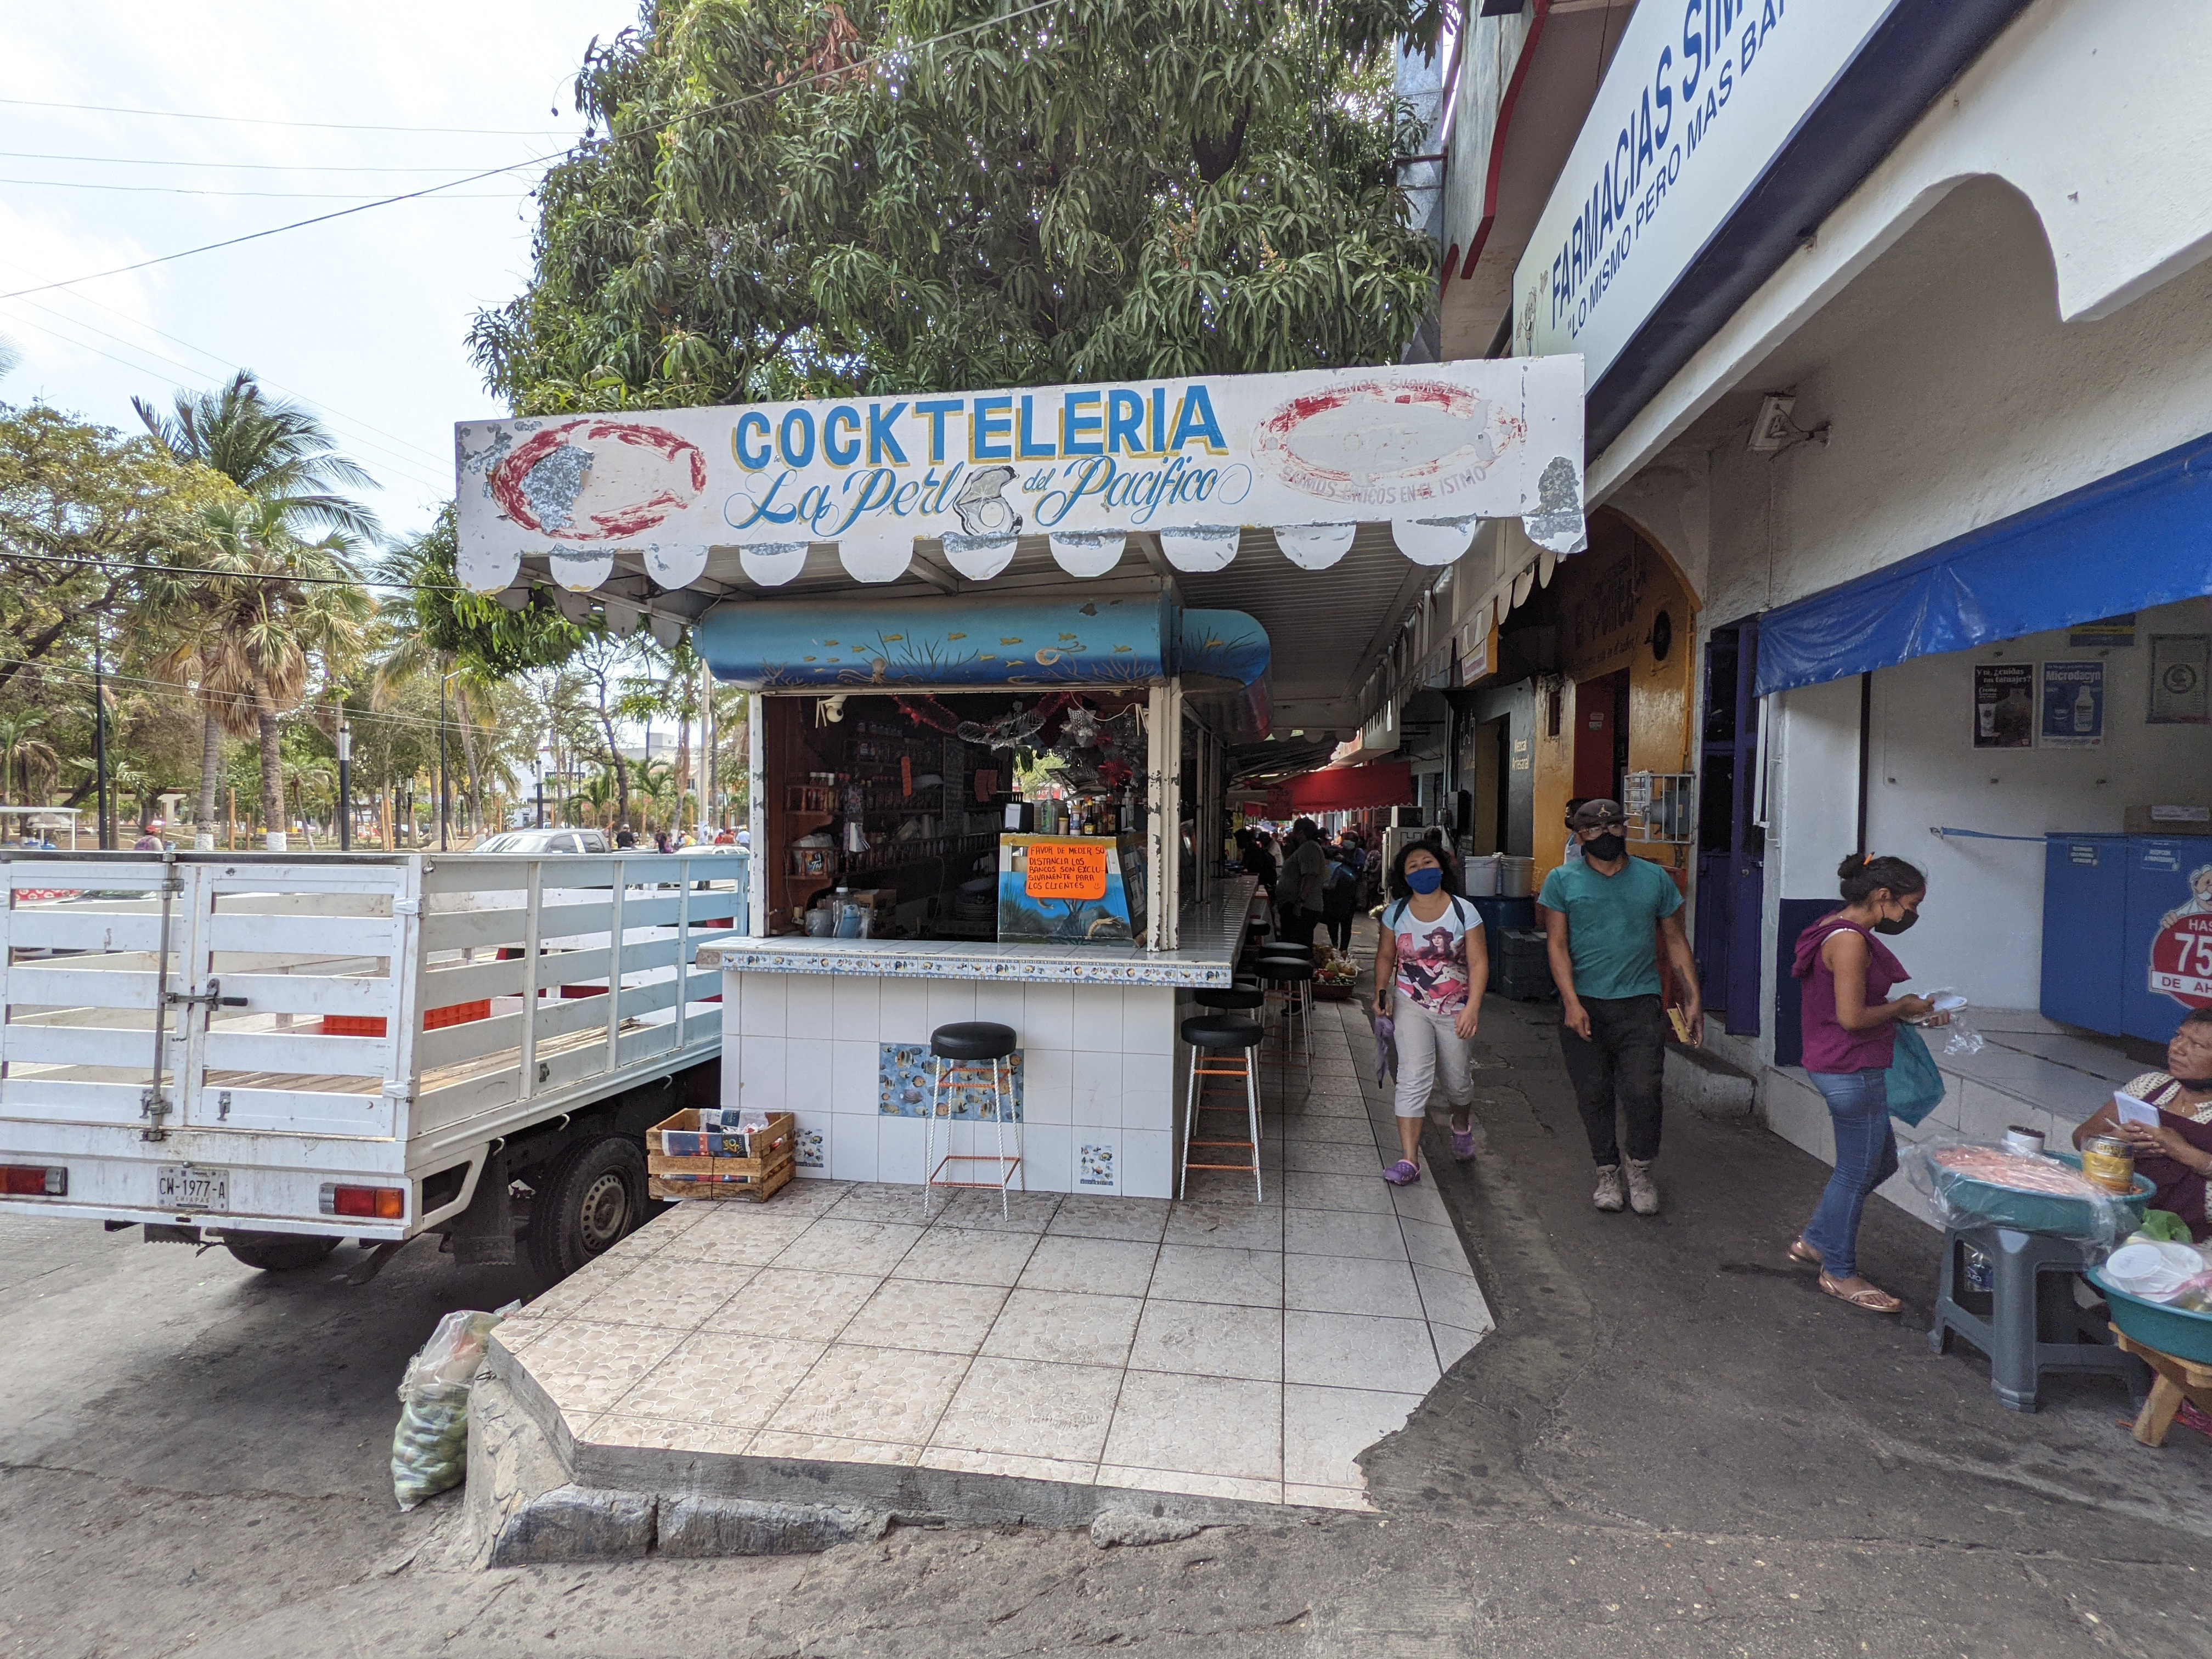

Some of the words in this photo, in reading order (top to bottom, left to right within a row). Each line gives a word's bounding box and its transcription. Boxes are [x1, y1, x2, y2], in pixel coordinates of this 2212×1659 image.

[1552, 45, 1672, 331] FARMACIAS
[1590, 225, 1630, 313] MISMO
[1636, 145, 1680, 240] PERO
[1688, 59, 1732, 160] MAS
[732, 385, 1228, 470] COCKTELERIA
[1023, 468, 1056, 493] del
[1279, 466, 1338, 498] SOMOS
[1400, 486, 1415, 503] EN
[1417, 482, 1436, 500] EL
[1440, 465, 1487, 496] ISTMO
[1035, 455, 1251, 527] Pacifico
[724, 469, 831, 537] La
[2046, 670, 2101, 683] Microdacyn
[1514, 738, 1527, 753] Mezcal
[1511, 754, 1529, 770] Artesanal
[1031, 846, 1053, 855] FAVOR
[1069, 847, 1092, 855] MEDIR
[1029, 857, 1069, 866] DISTANCIA
[1072, 857, 1085, 866] LOS
[1028, 873, 1071, 881] SIVAMENTE
[1045, 882, 1085, 890] CLIENTES
[2161, 976, 2181, 989] DE
[160, 1177, 225, 1199] CW-1977-A
